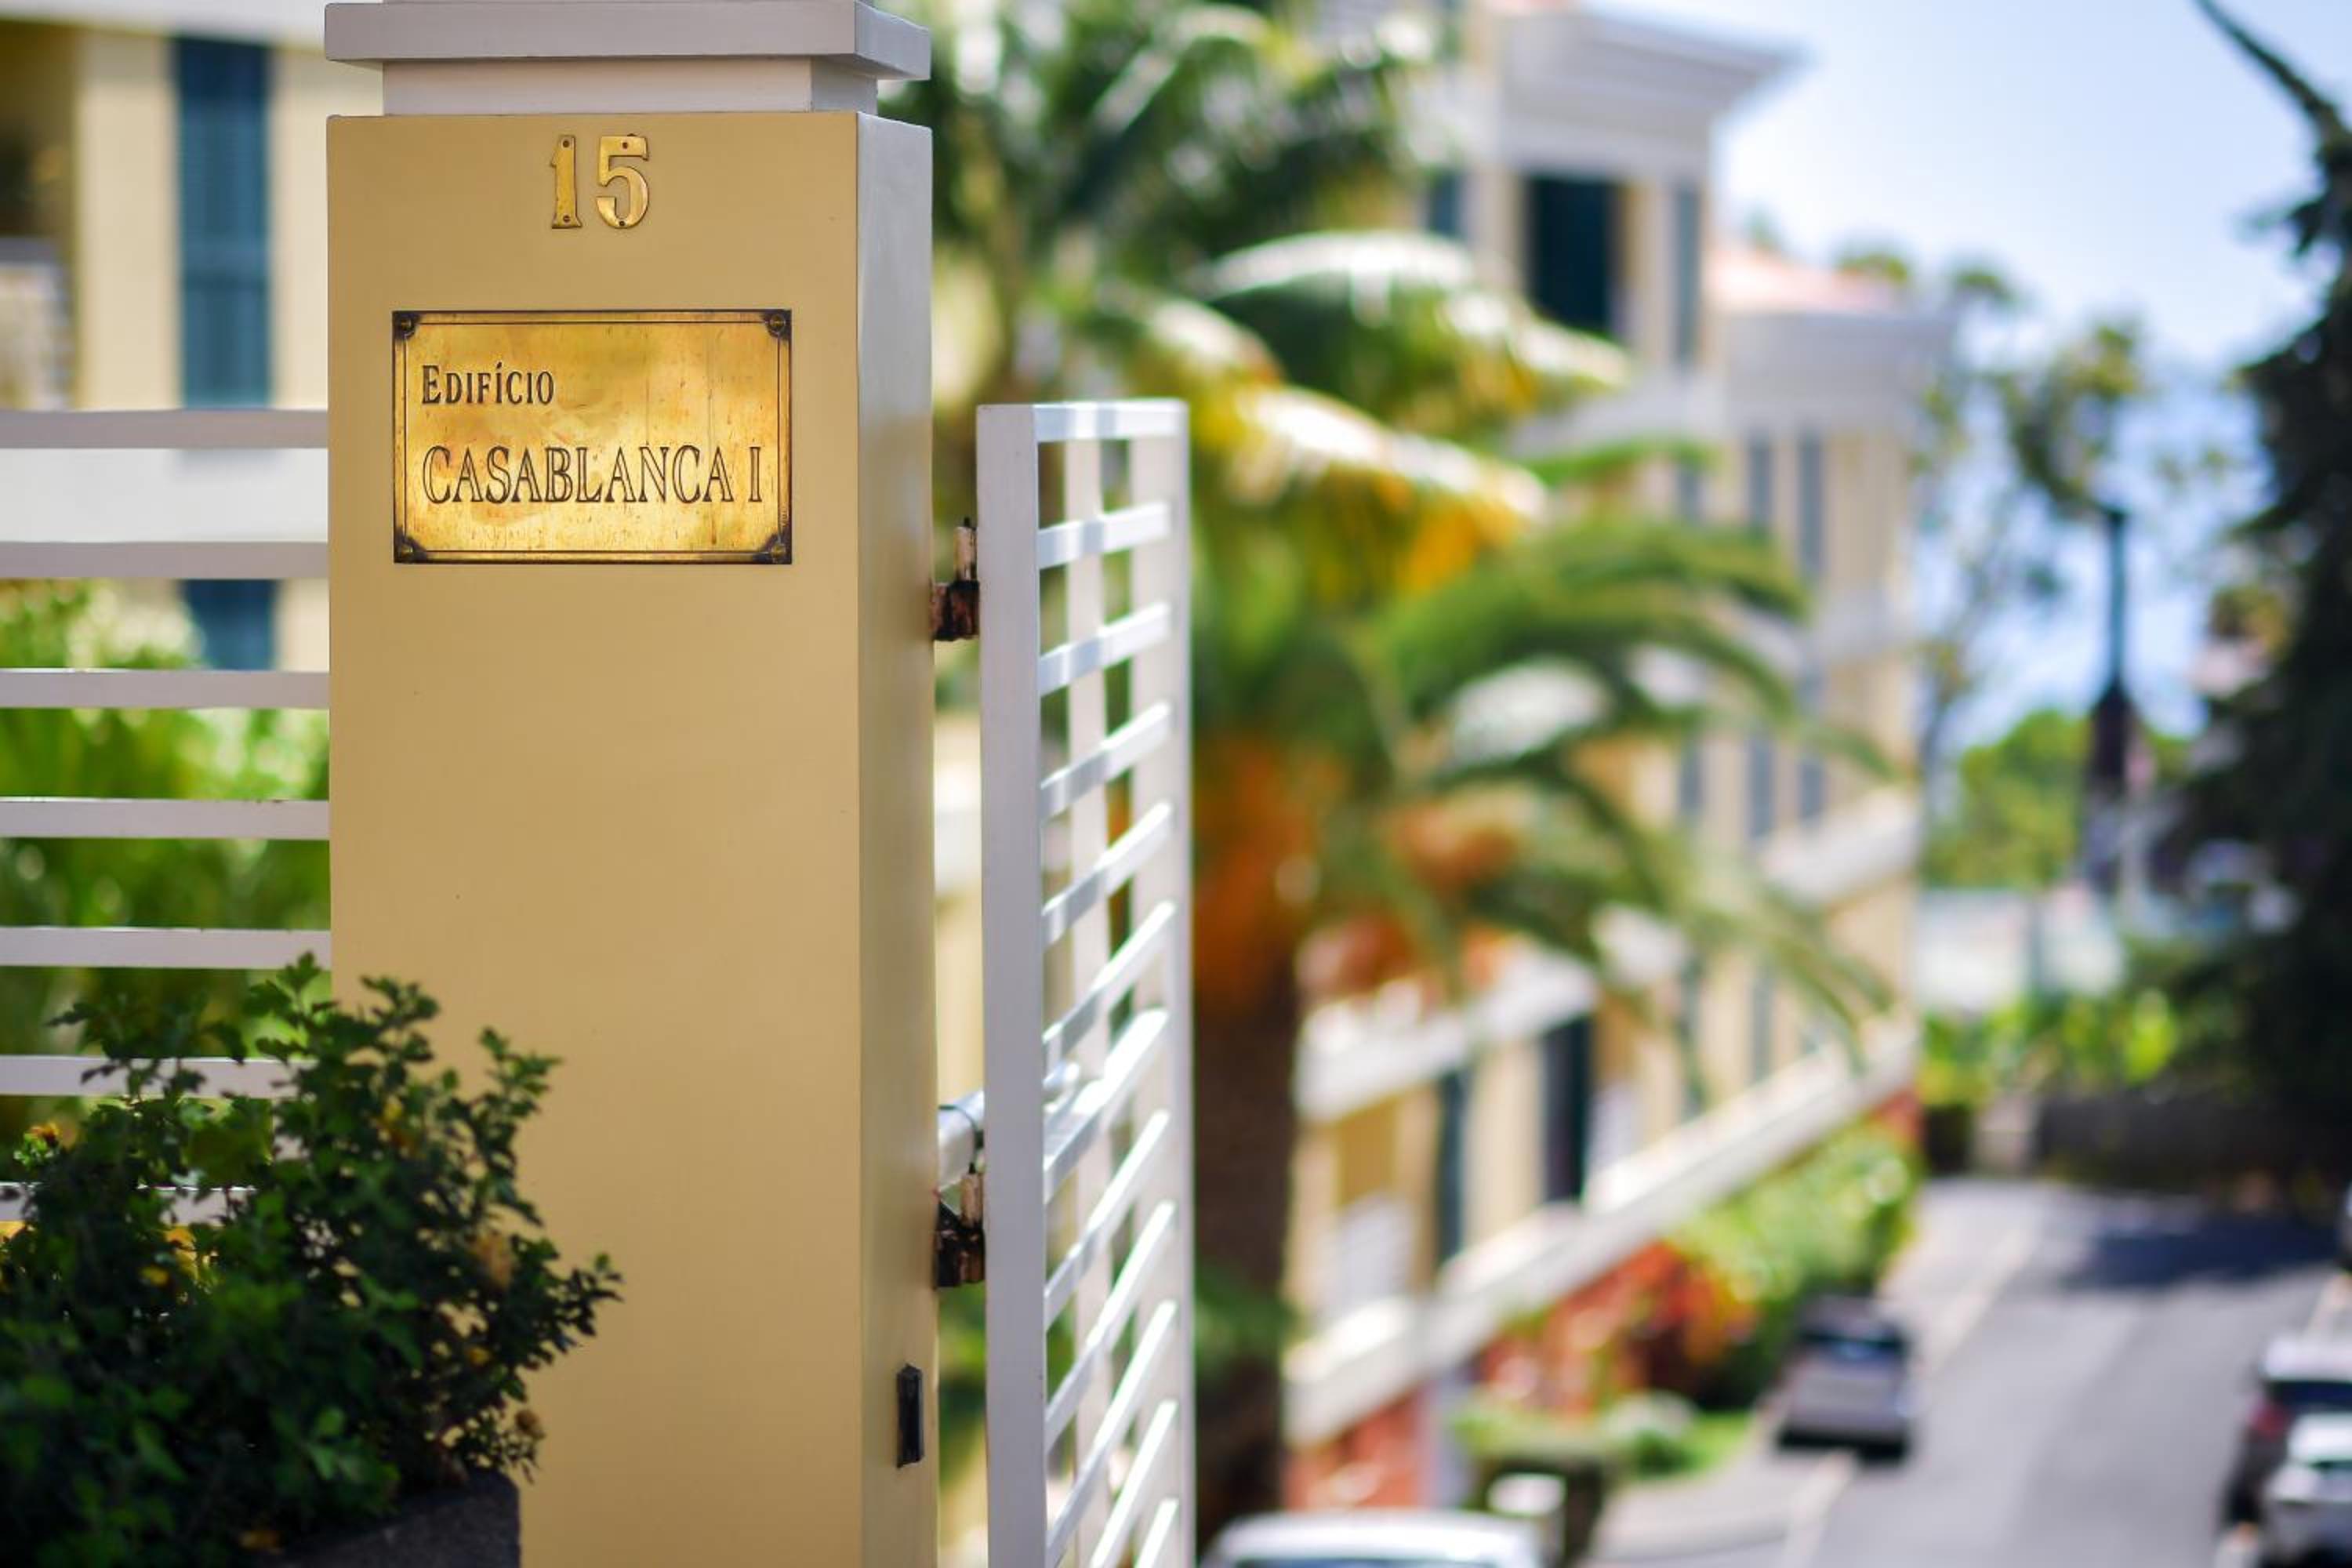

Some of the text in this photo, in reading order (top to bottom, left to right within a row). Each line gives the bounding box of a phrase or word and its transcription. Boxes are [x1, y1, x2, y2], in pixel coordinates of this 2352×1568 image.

[550, 134, 649, 230] 15
[422, 445, 763, 504] CASABLANCA I
